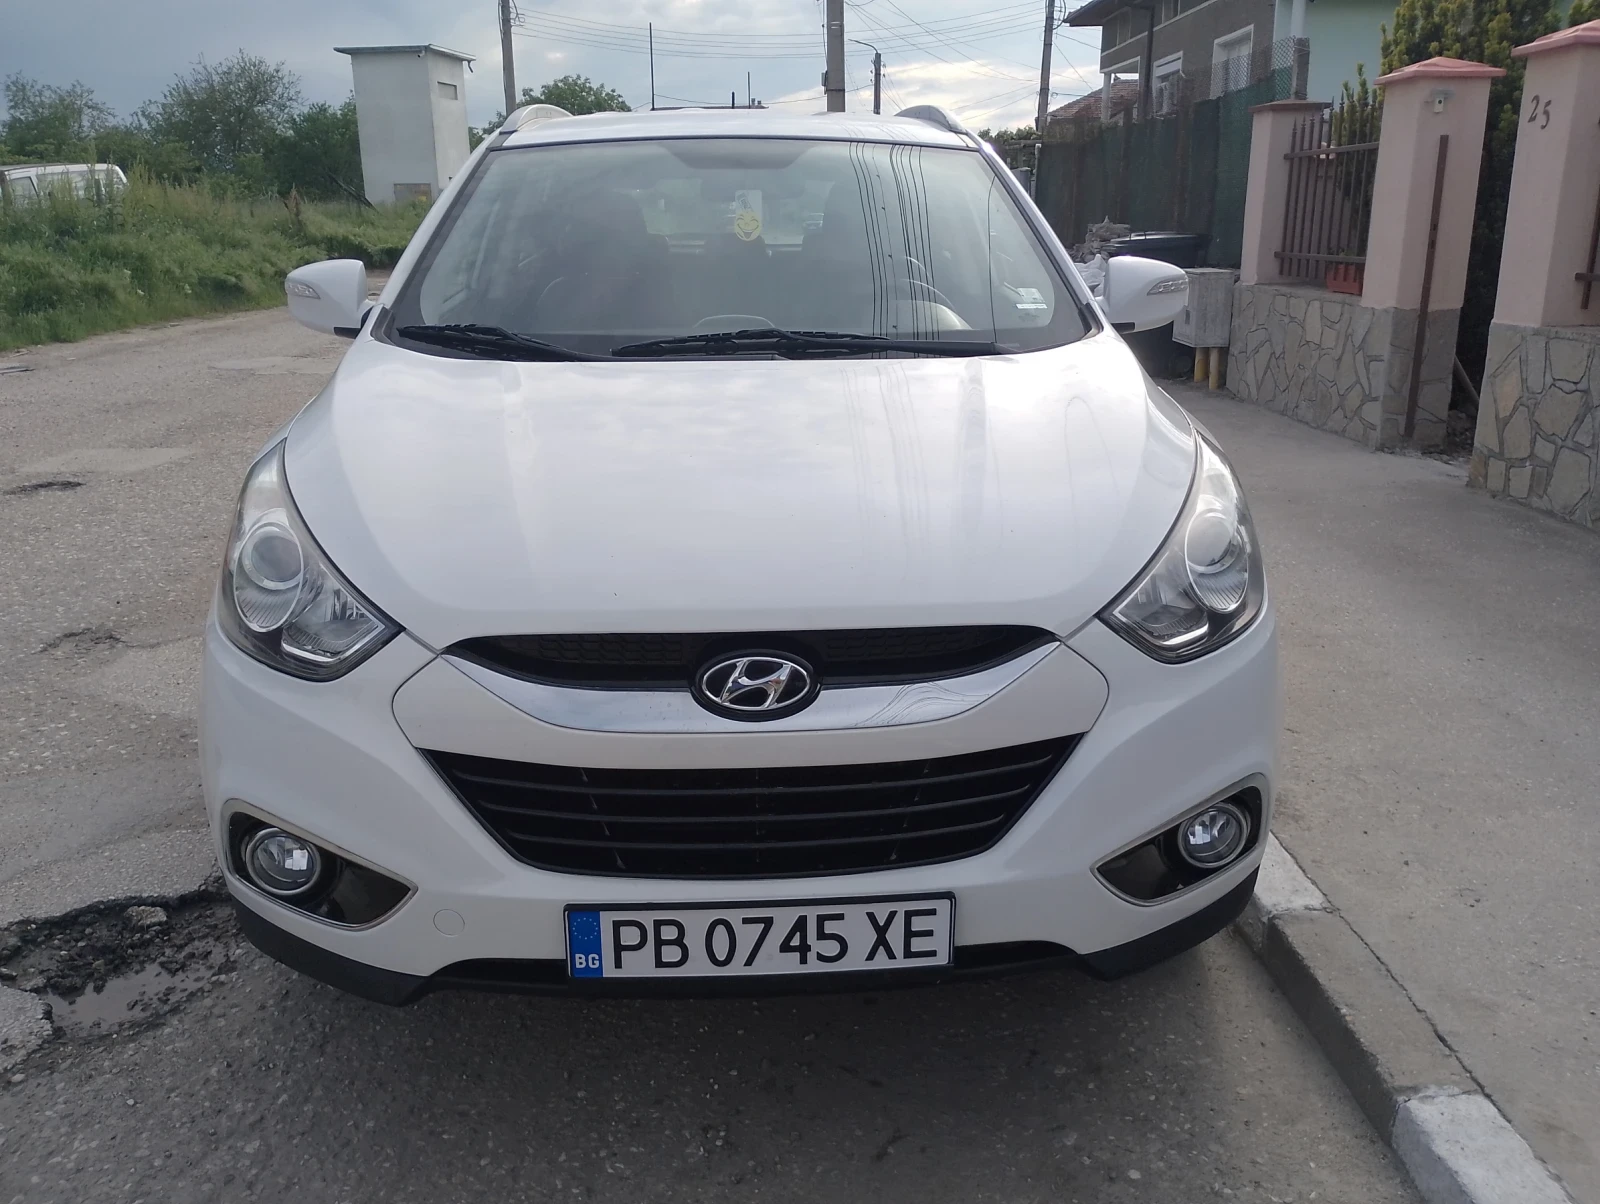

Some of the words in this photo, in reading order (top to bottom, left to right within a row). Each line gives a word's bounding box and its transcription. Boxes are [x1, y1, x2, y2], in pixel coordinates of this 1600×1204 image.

[1527, 94, 1552, 130] 25
[612, 918, 690, 969] PB
[704, 912, 849, 968] 0745
[864, 908, 938, 962] XE
[575, 954, 600, 969] BG
